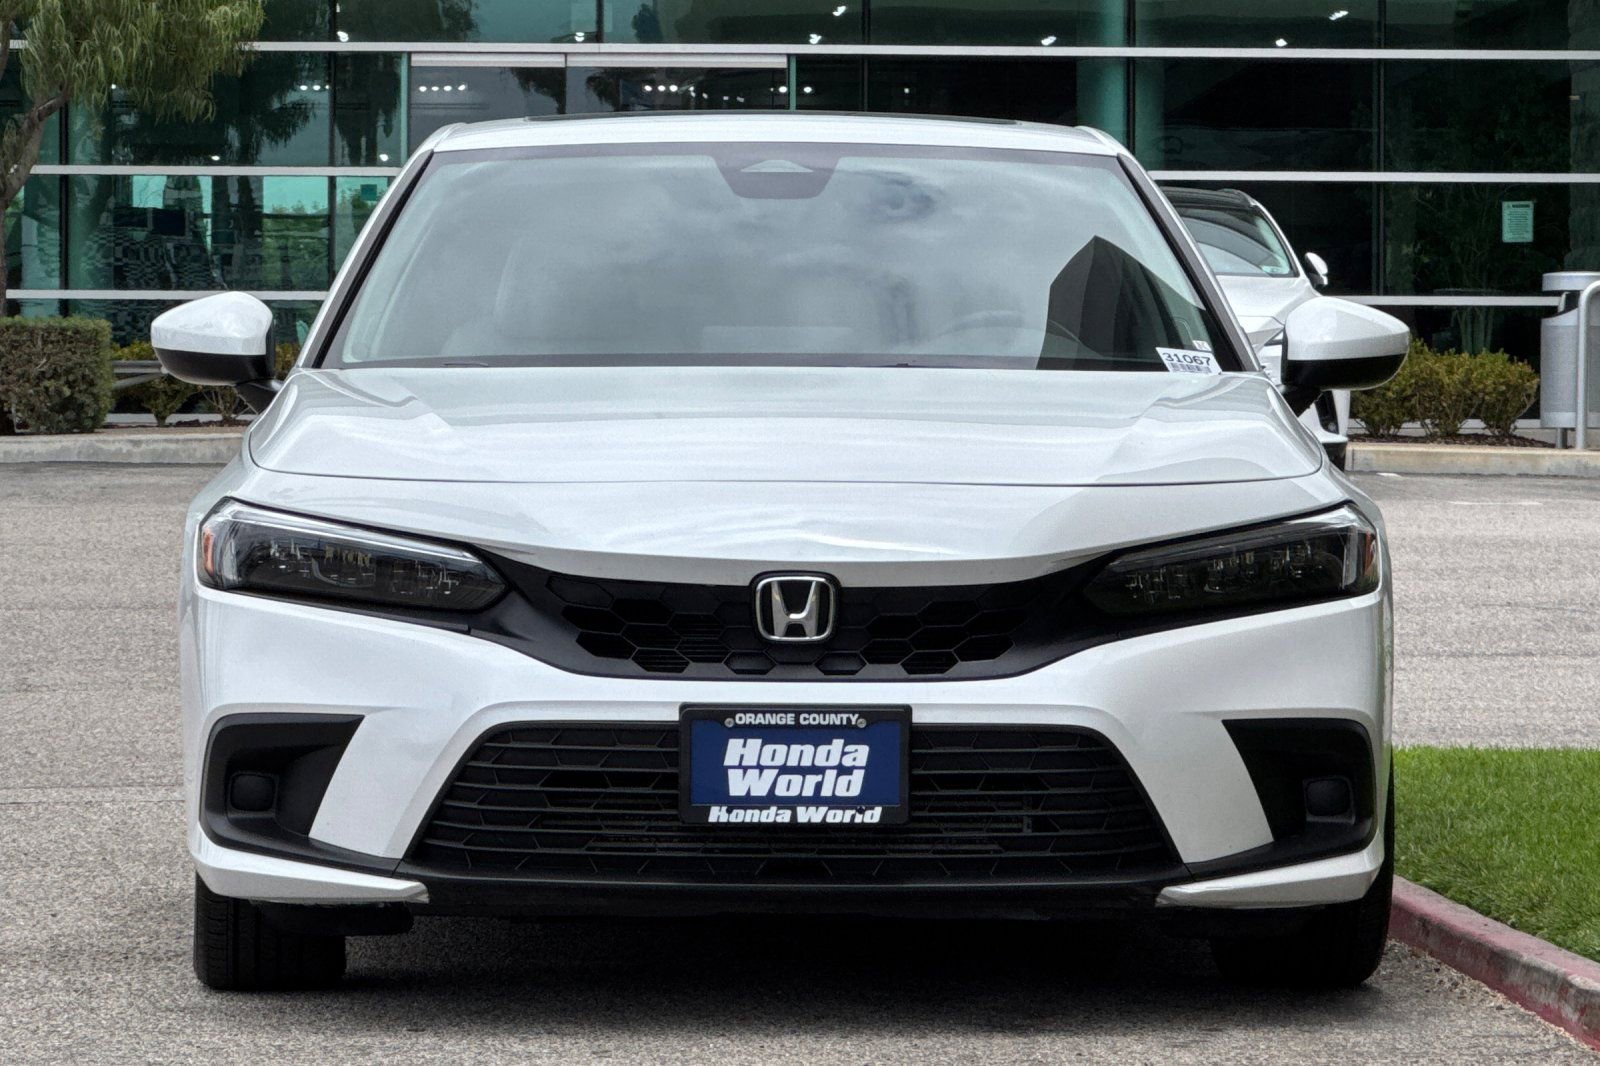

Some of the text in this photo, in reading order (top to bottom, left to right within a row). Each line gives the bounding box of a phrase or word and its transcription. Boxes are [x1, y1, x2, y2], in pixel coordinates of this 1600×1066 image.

[1162, 352, 1211, 366] 31067
[735, 713, 859, 725] ORANGE COUNTY
[724, 738, 869, 766] Honda
[727, 769, 865, 796] World
[708, 806, 882, 823] Honda World
